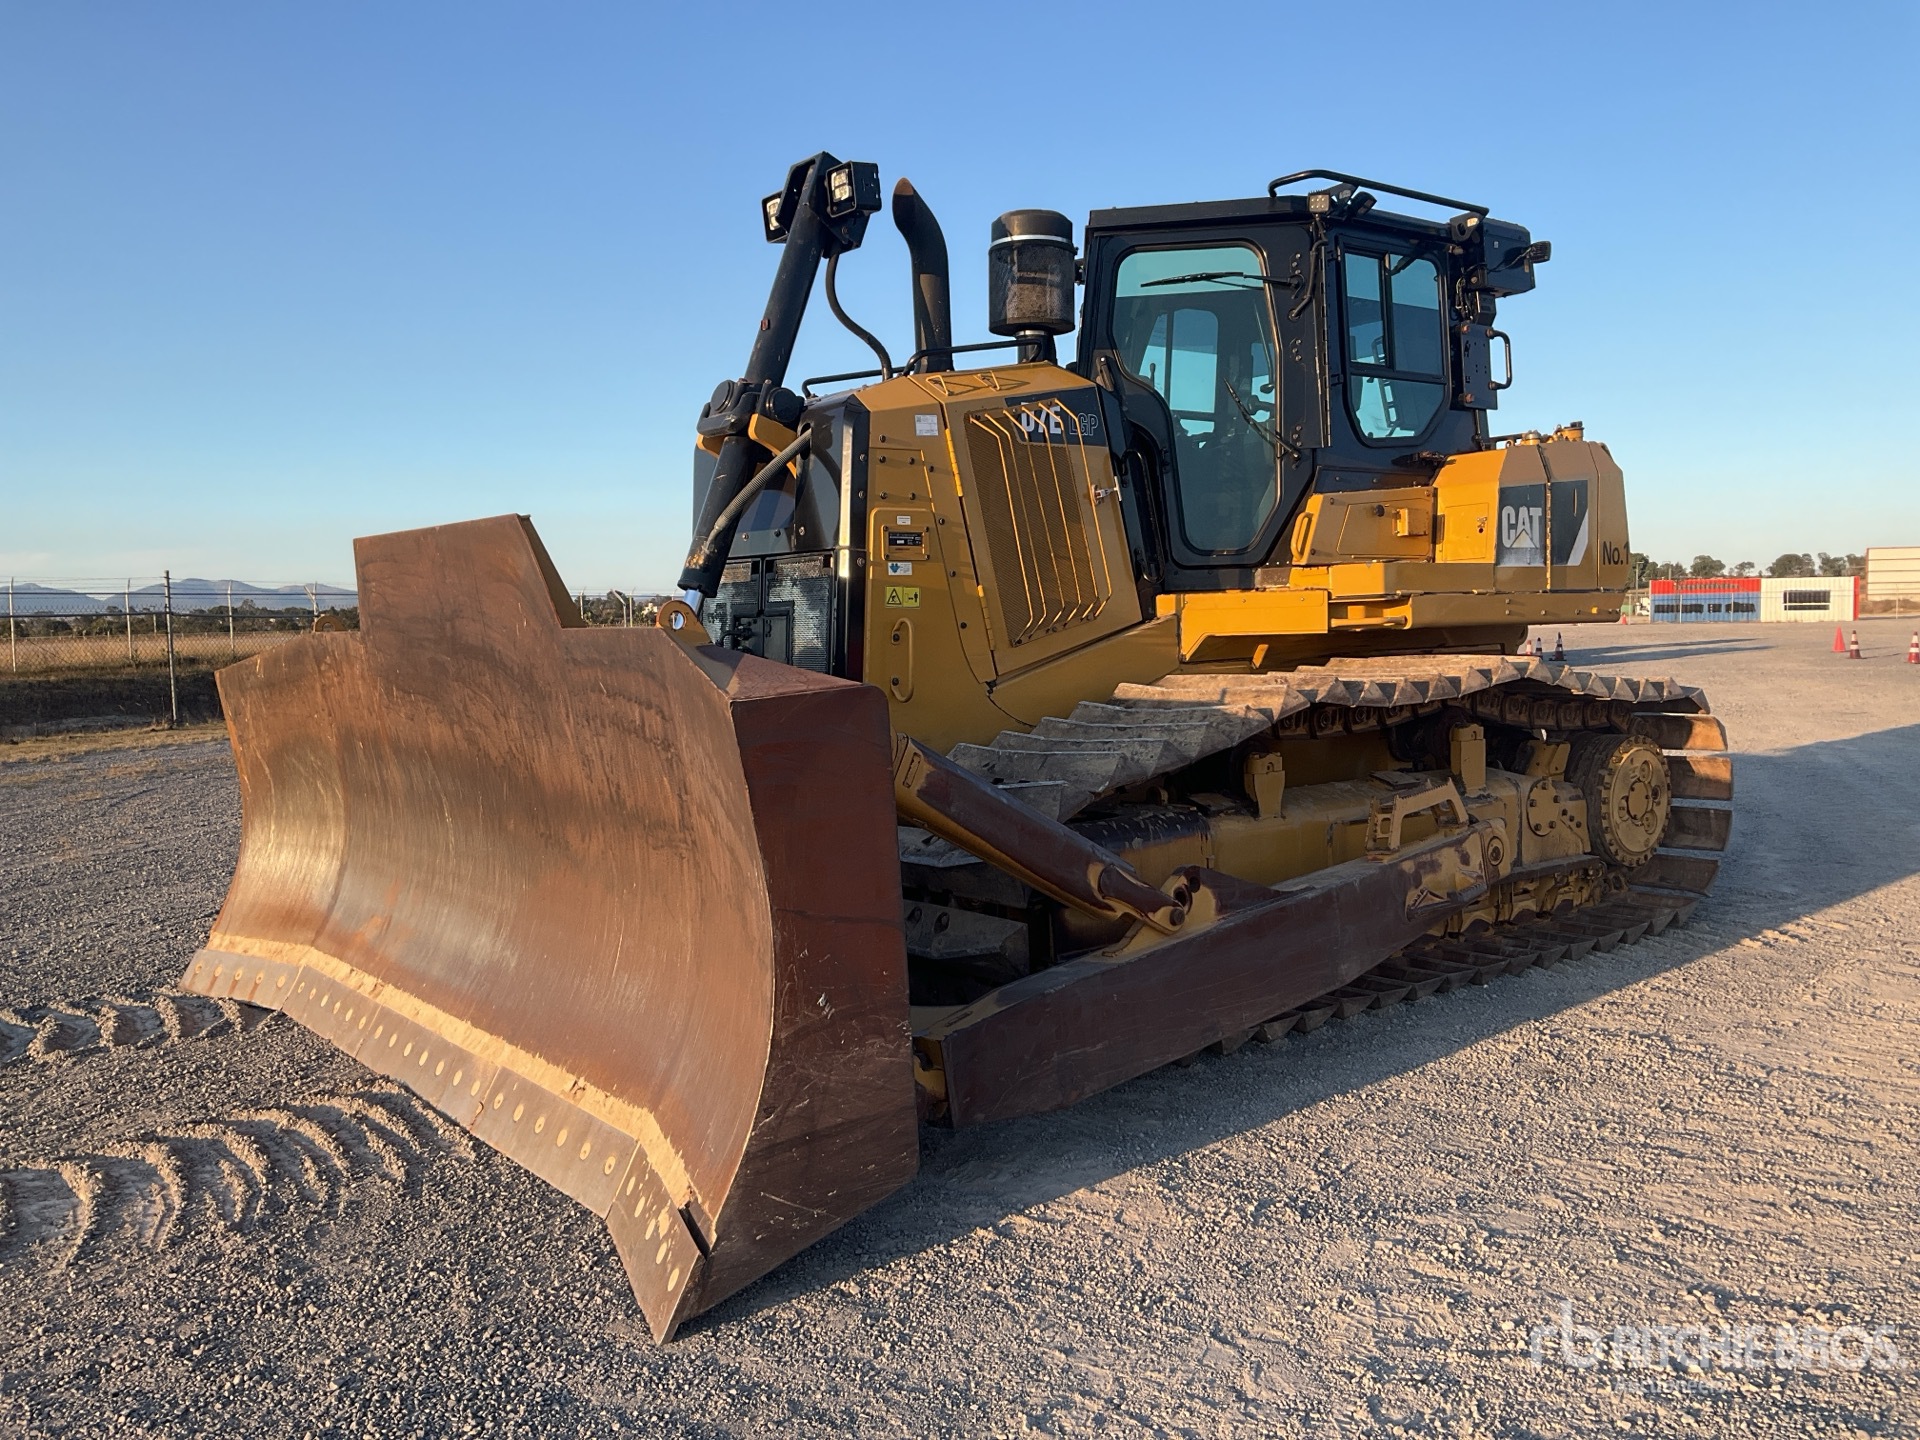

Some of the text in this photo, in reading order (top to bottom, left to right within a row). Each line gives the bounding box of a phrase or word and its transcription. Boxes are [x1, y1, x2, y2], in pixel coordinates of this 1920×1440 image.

[1069, 412, 1098, 436] LGP
[1501, 505, 1542, 548] CAT
[1602, 541, 1629, 565] No.1
